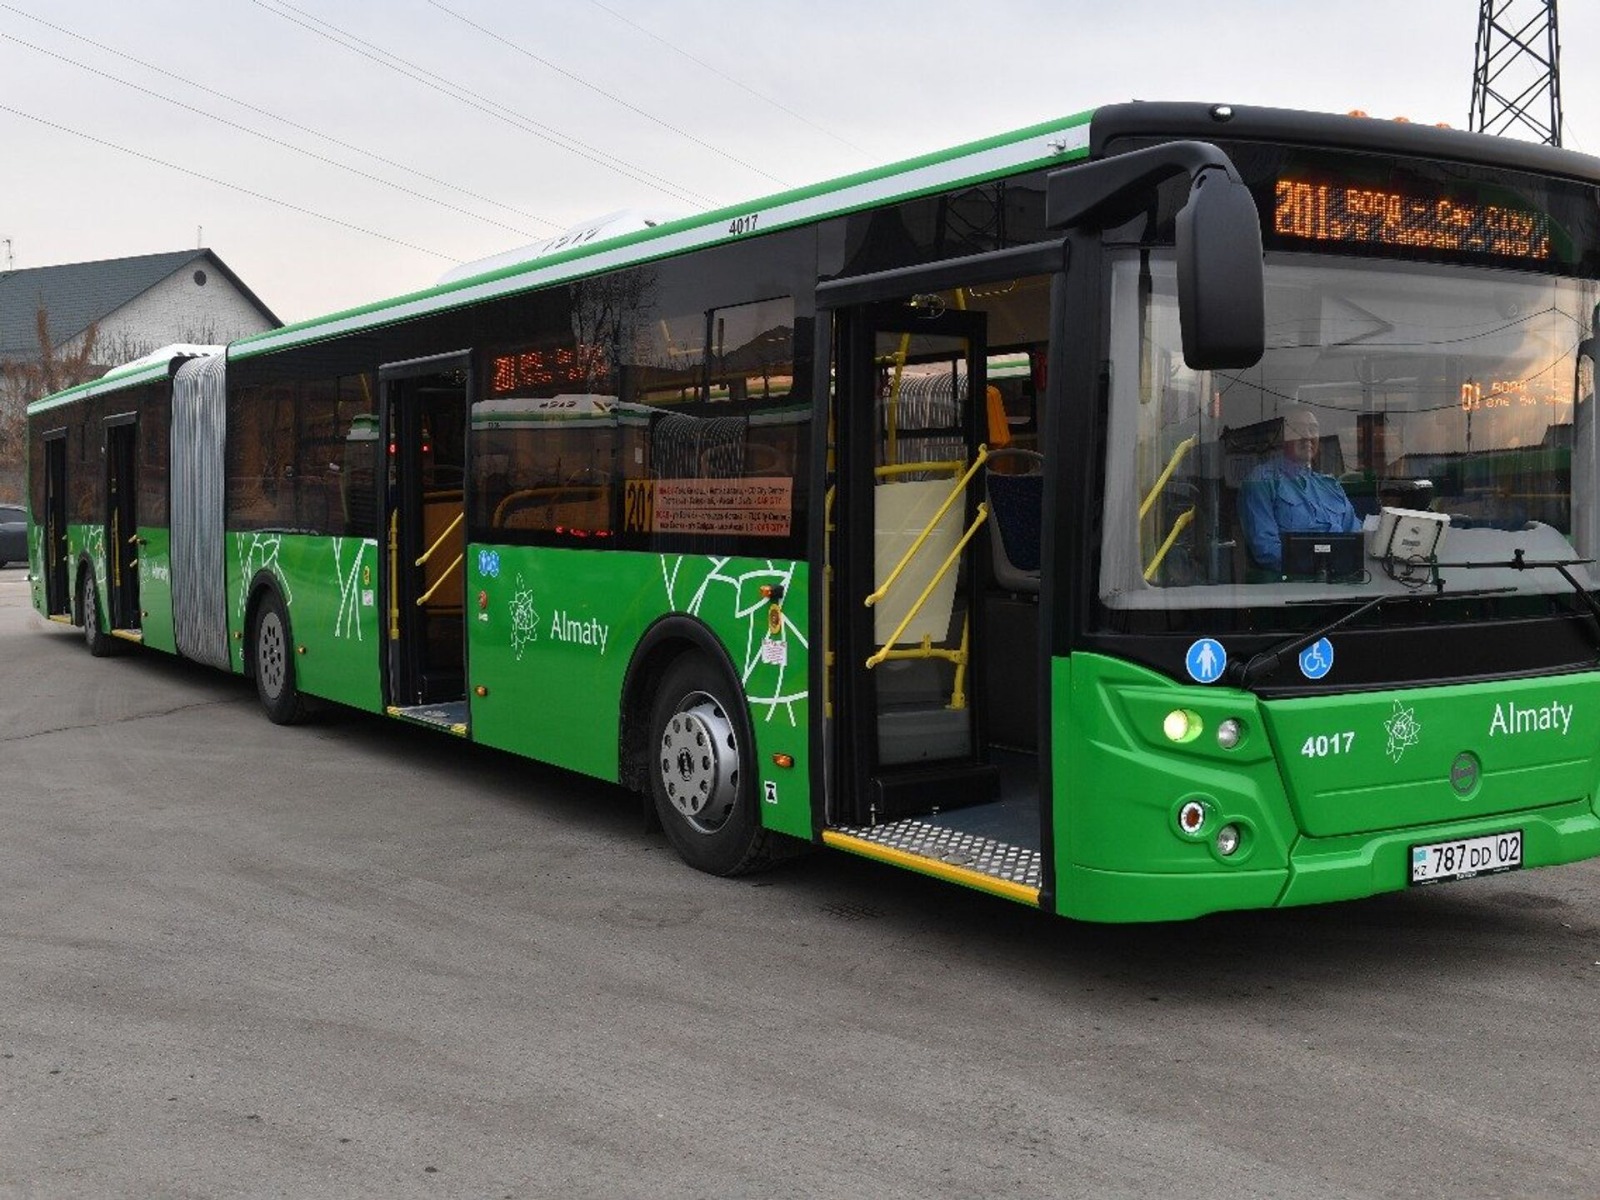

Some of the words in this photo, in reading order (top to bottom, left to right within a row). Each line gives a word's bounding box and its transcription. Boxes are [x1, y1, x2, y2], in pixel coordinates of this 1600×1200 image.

[728, 213, 759, 236] 4017
[1276, 180, 1327, 239] 201
[1438, 201, 1473, 226] Car
[1488, 207, 1532, 235] City
[627, 482, 654, 532] 201
[550, 609, 608, 655] Almaty
[1301, 731, 1356, 759] 4017
[1489, 700, 1574, 737] Almaty
[1432, 844, 1466, 873] 787
[1470, 846, 1491, 868] DD
[1498, 836, 1520, 863] 02
